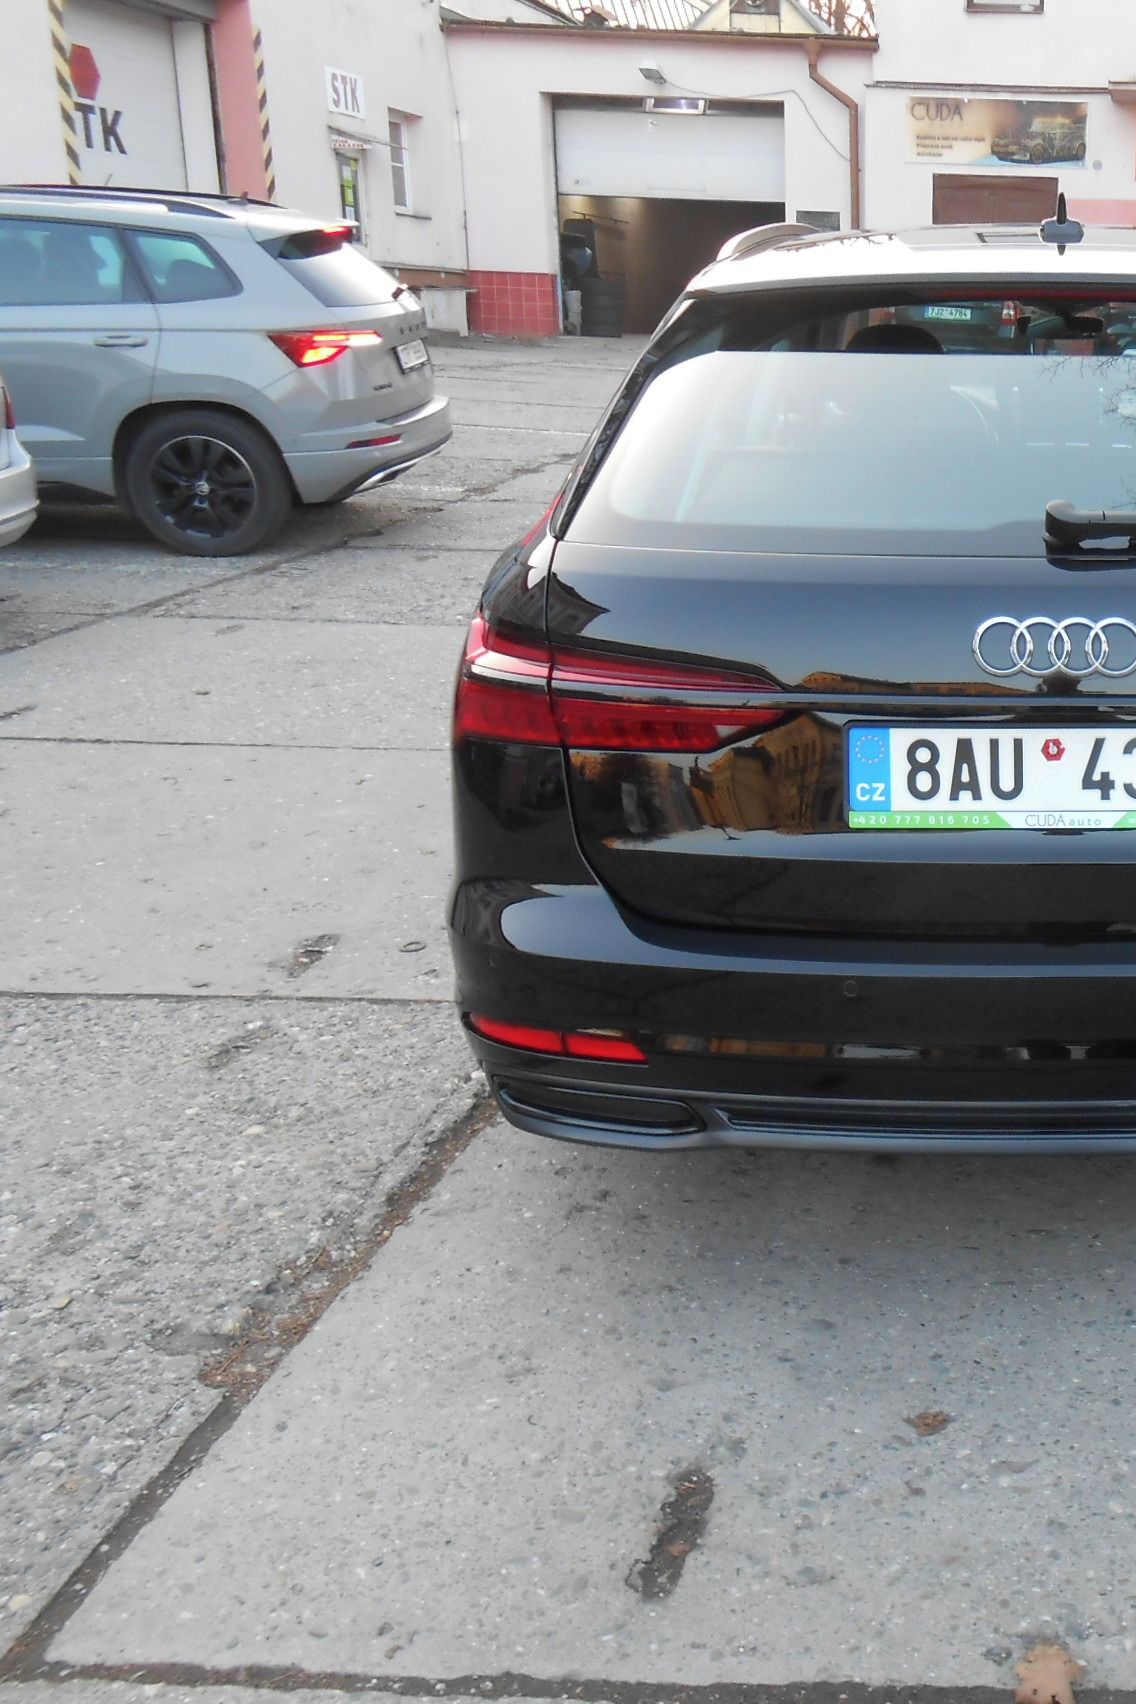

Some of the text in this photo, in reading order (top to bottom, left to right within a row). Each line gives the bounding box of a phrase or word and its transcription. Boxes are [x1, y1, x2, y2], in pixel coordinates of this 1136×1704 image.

[331, 72, 361, 113] STK
[74, 102, 128, 155] TK
[906, 738, 1024, 801] 8AU
[855, 782, 887, 801] CZ
[853, 815, 990, 825] +420 777 816 705
[1069, 817, 1102, 826] auto
